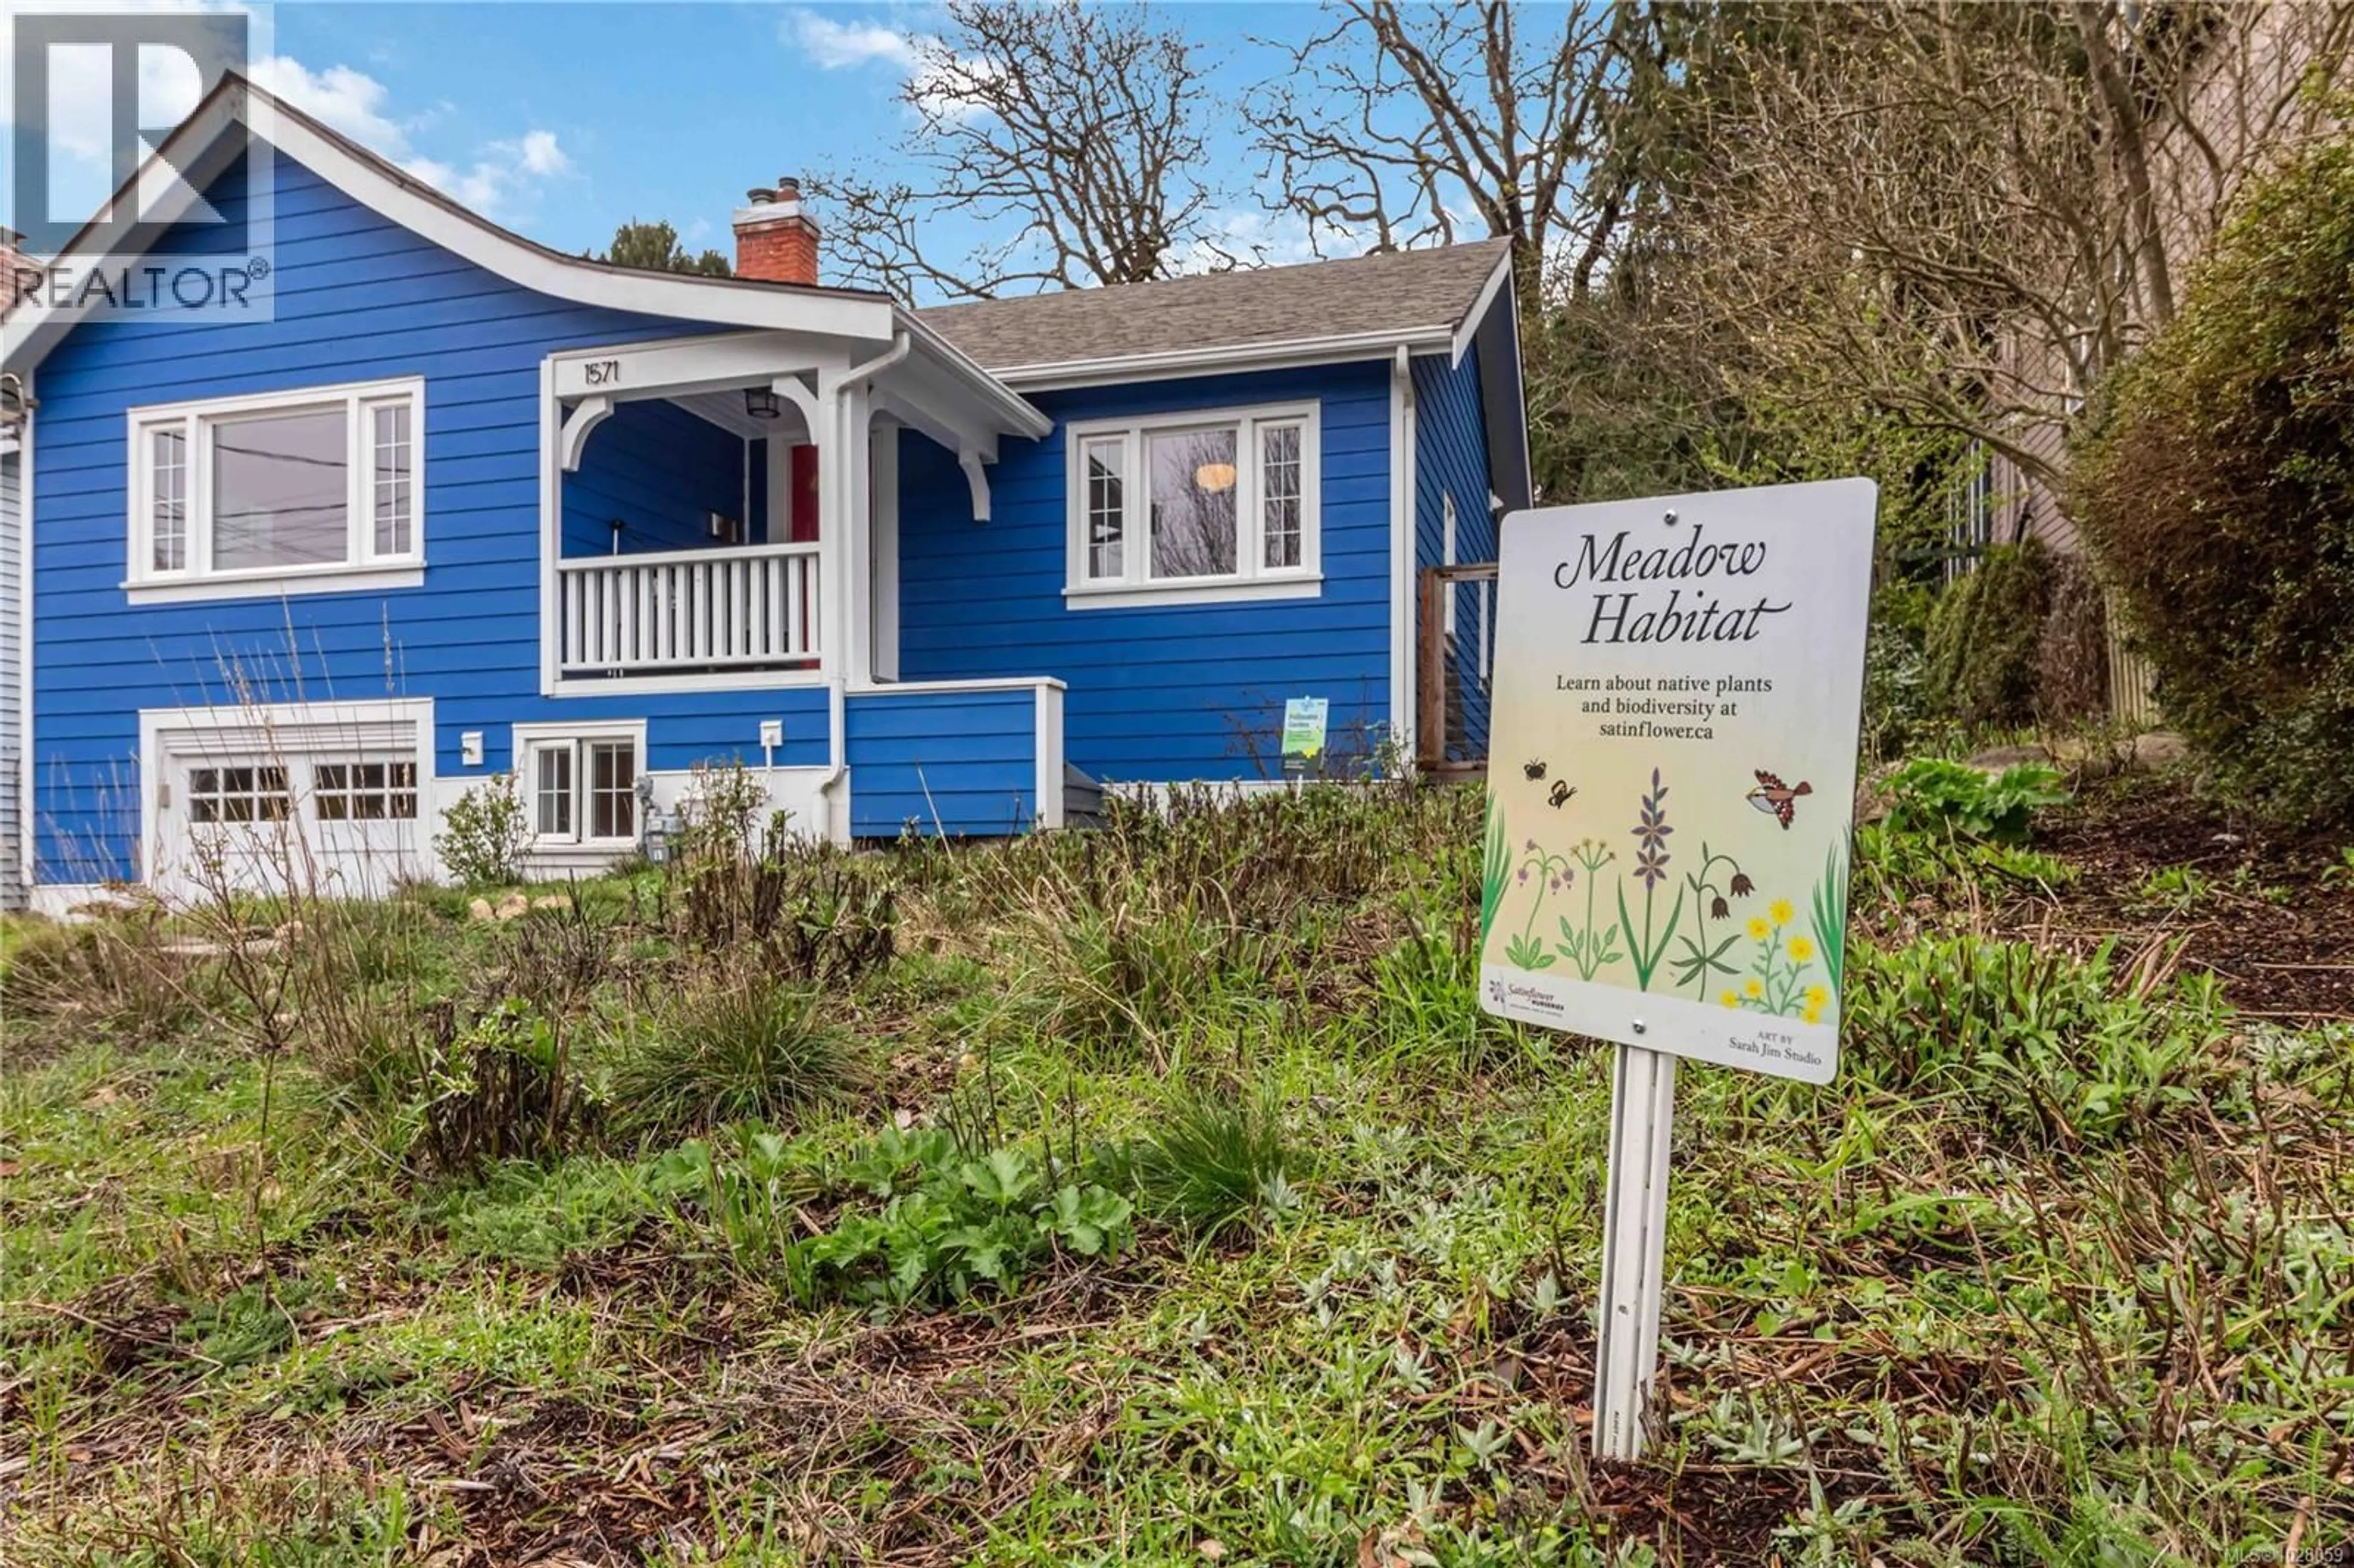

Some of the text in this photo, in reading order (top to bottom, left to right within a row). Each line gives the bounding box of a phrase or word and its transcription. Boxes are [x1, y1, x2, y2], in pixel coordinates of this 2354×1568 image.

[584, 360, 619, 384] 1571
[1554, 524, 1766, 589] Meadow
[1580, 590, 1792, 644] Habitat
[1556, 675, 1772, 698] Learn about native plants
[1582, 698, 1737, 721] and biodiversity at
[1599, 721, 1714, 740] satinflower.ca
[1757, 1031, 1794, 1045] ART BY
[1729, 1037, 1822, 1065] Sarah Jim Studio
